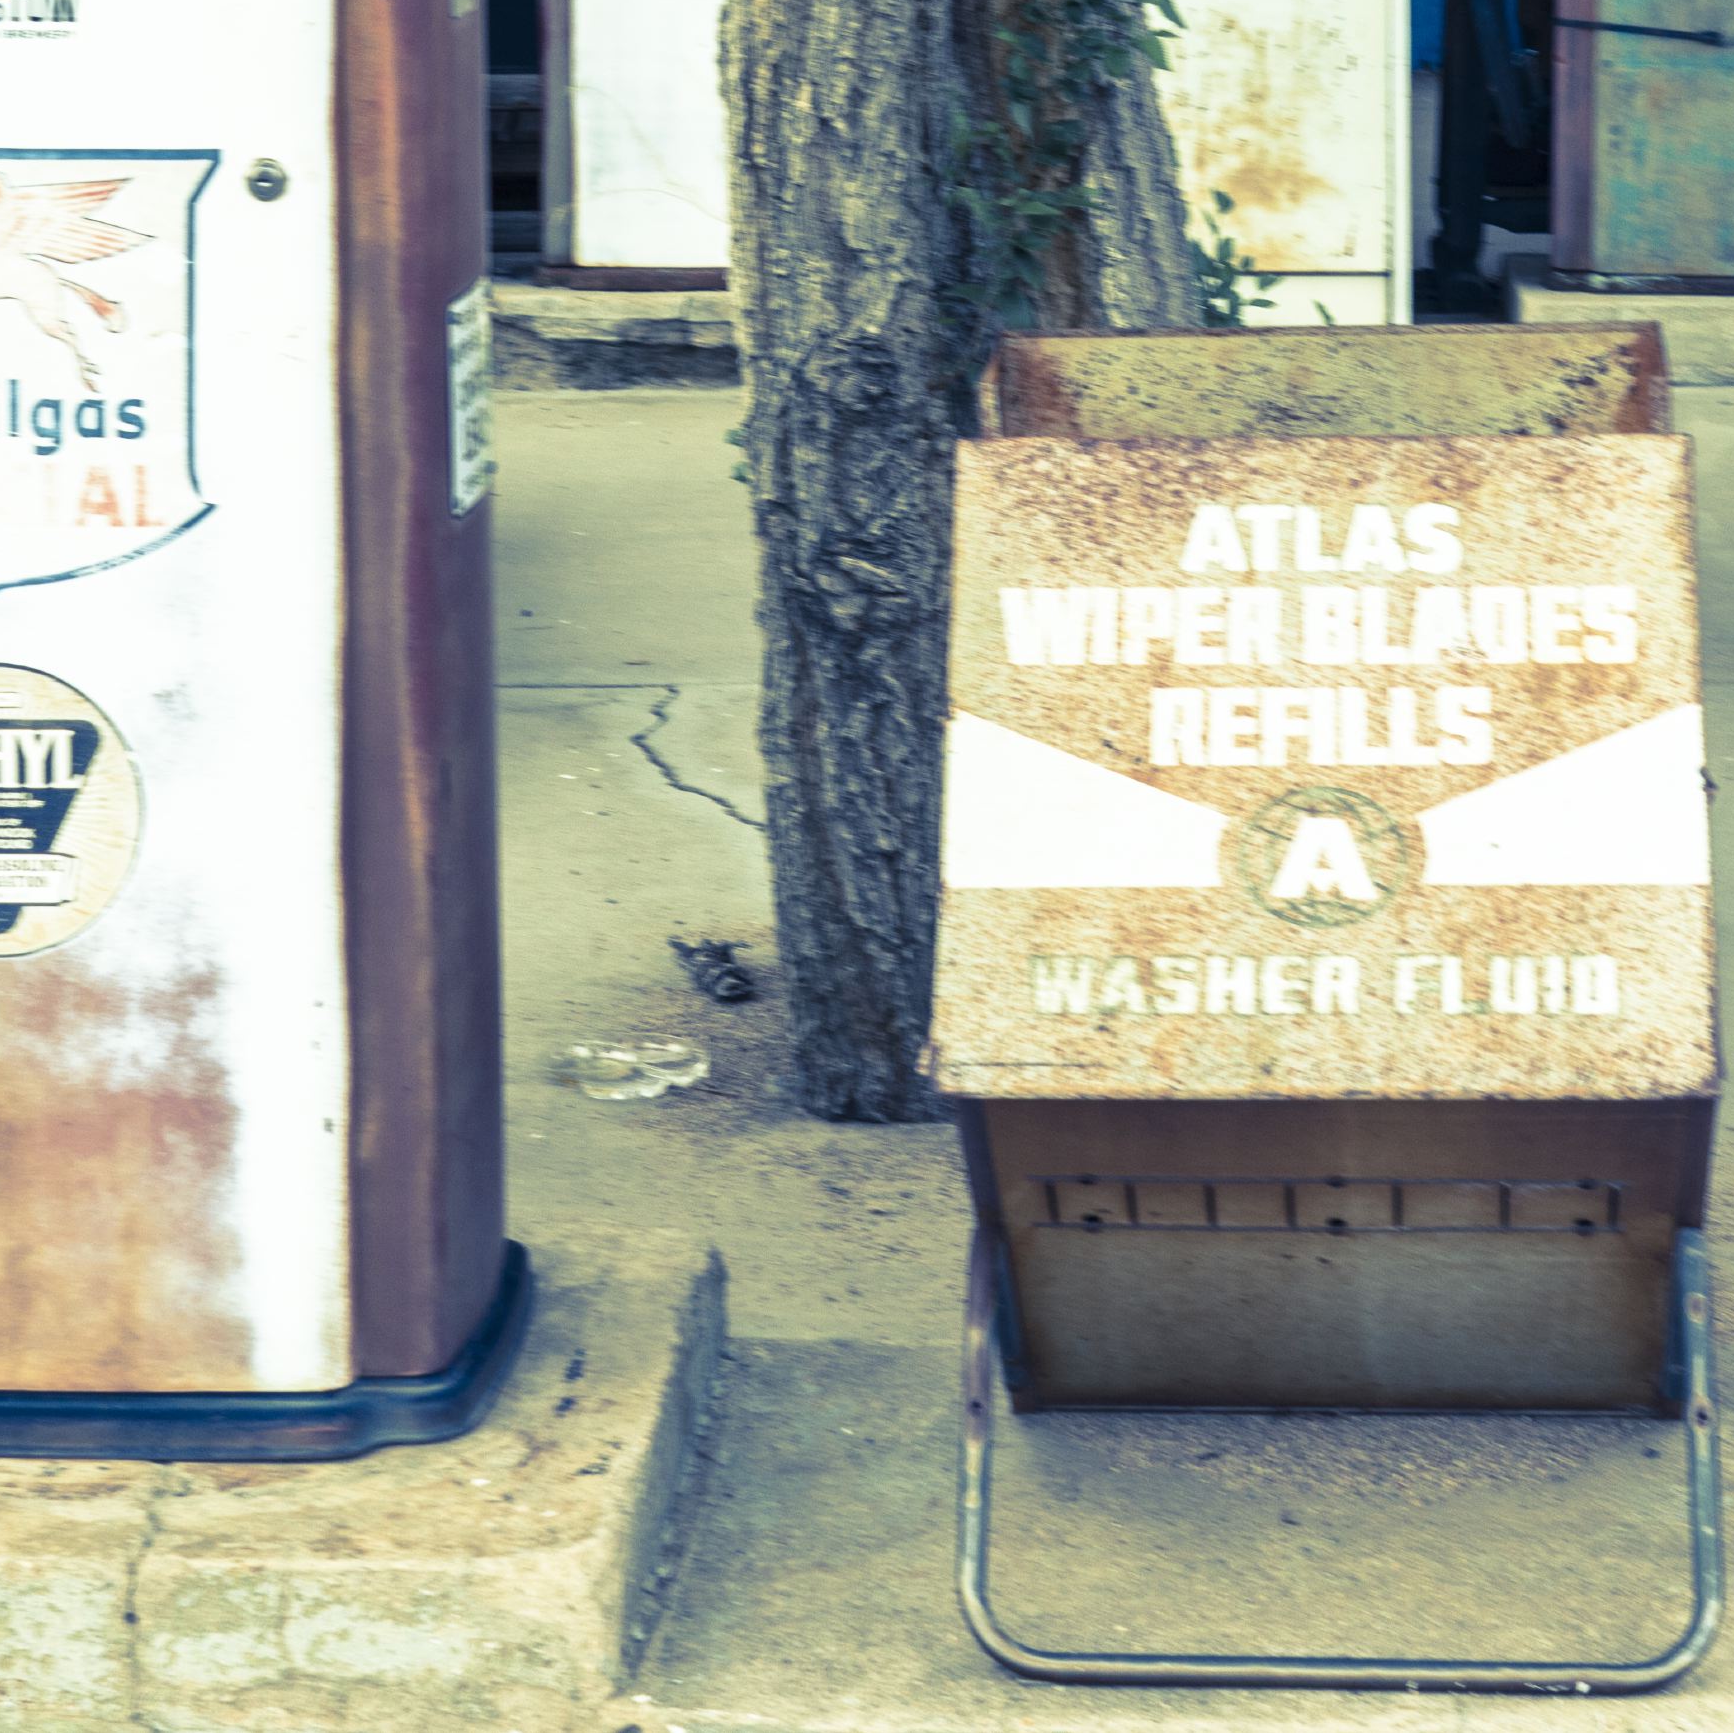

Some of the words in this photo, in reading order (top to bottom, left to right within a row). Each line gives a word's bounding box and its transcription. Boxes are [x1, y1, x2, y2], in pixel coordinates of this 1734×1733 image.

[1177, 502, 1465, 574] ATLAS
[998, 585, 1281, 666] WIPER
[1298, 585, 1640, 665] BLADES
[1147, 685, 1494, 766] REFILLS
[1267, 814, 1379, 900] A
[1029, 952, 1362, 1017] WASHER
[1393, 951, 1622, 1016] FLUID
